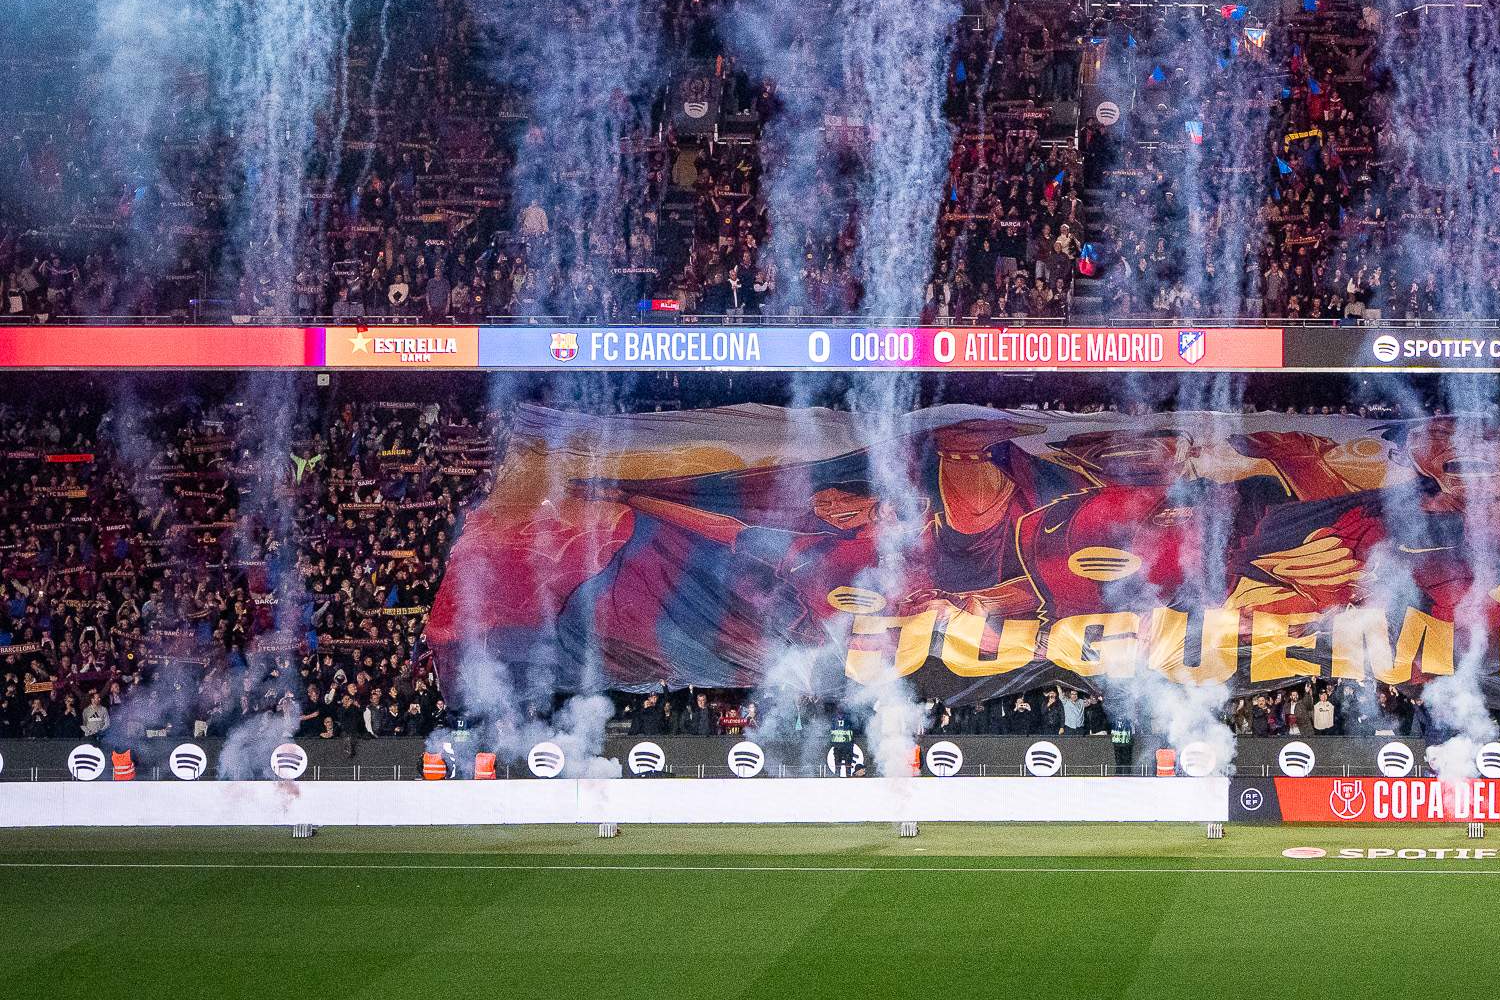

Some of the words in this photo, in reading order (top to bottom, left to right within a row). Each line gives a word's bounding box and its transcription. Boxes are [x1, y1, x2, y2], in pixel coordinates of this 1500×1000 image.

[374, 336, 457, 354] ESTRELLA
[401, 353, 431, 362] DAMM
[591, 332, 621, 361] FC
[625, 332, 761, 361] BARCELONA
[808, 330, 830, 363] 0
[850, 332, 914, 362] 00:00
[933, 331, 956, 363] 0
[964, 328, 1053, 362] ATLÉTICO
[1058, 334, 1082, 362] DE
[1086, 334, 1164, 362] MADRID
[1403, 339, 1489, 359] SPOTIFY
[0, 645, 36, 653] BARCELONA
[844, 605, 1455, 684] JUGUEM
[1373, 781, 1444, 820] COPA
